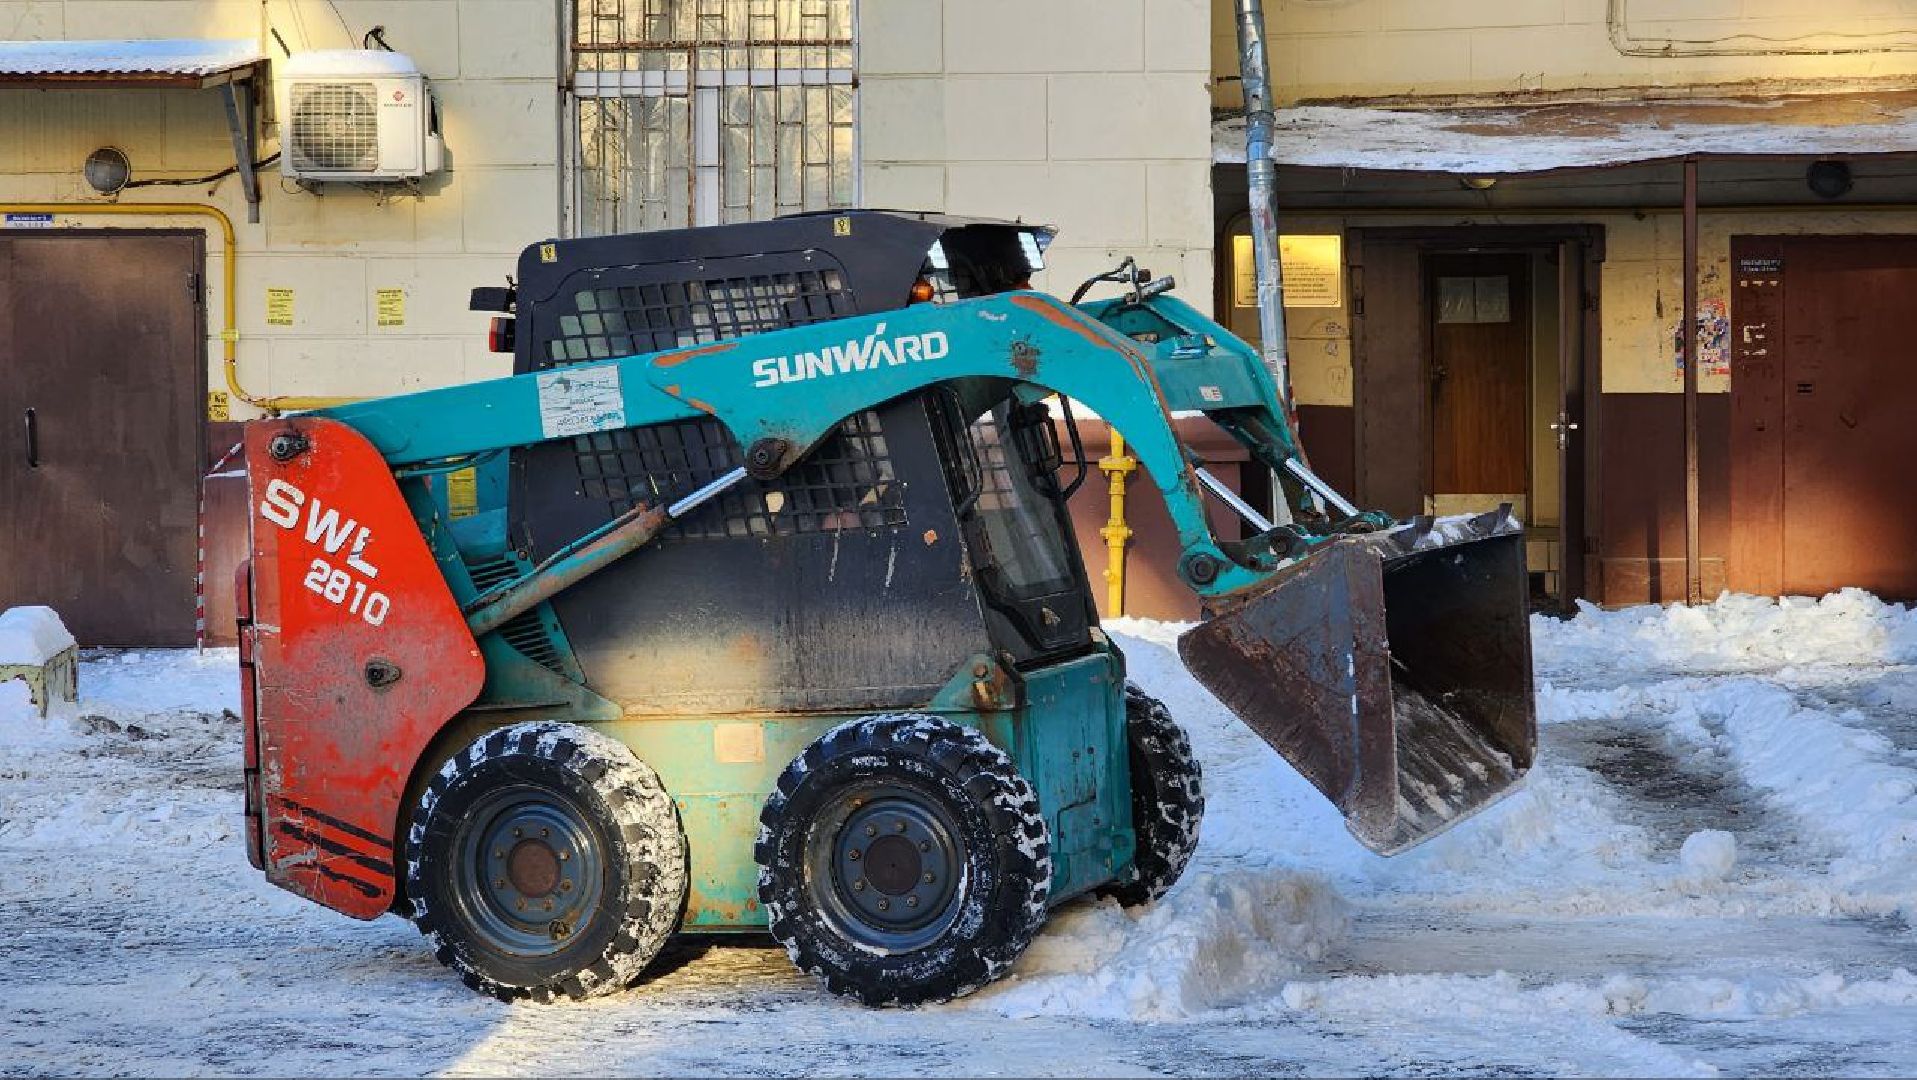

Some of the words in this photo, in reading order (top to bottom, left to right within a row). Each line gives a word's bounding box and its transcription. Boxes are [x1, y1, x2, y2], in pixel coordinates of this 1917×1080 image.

[752, 323, 949, 388] SUNWARD
[260, 479, 378, 578] SWL
[303, 558, 391, 626] 2810
